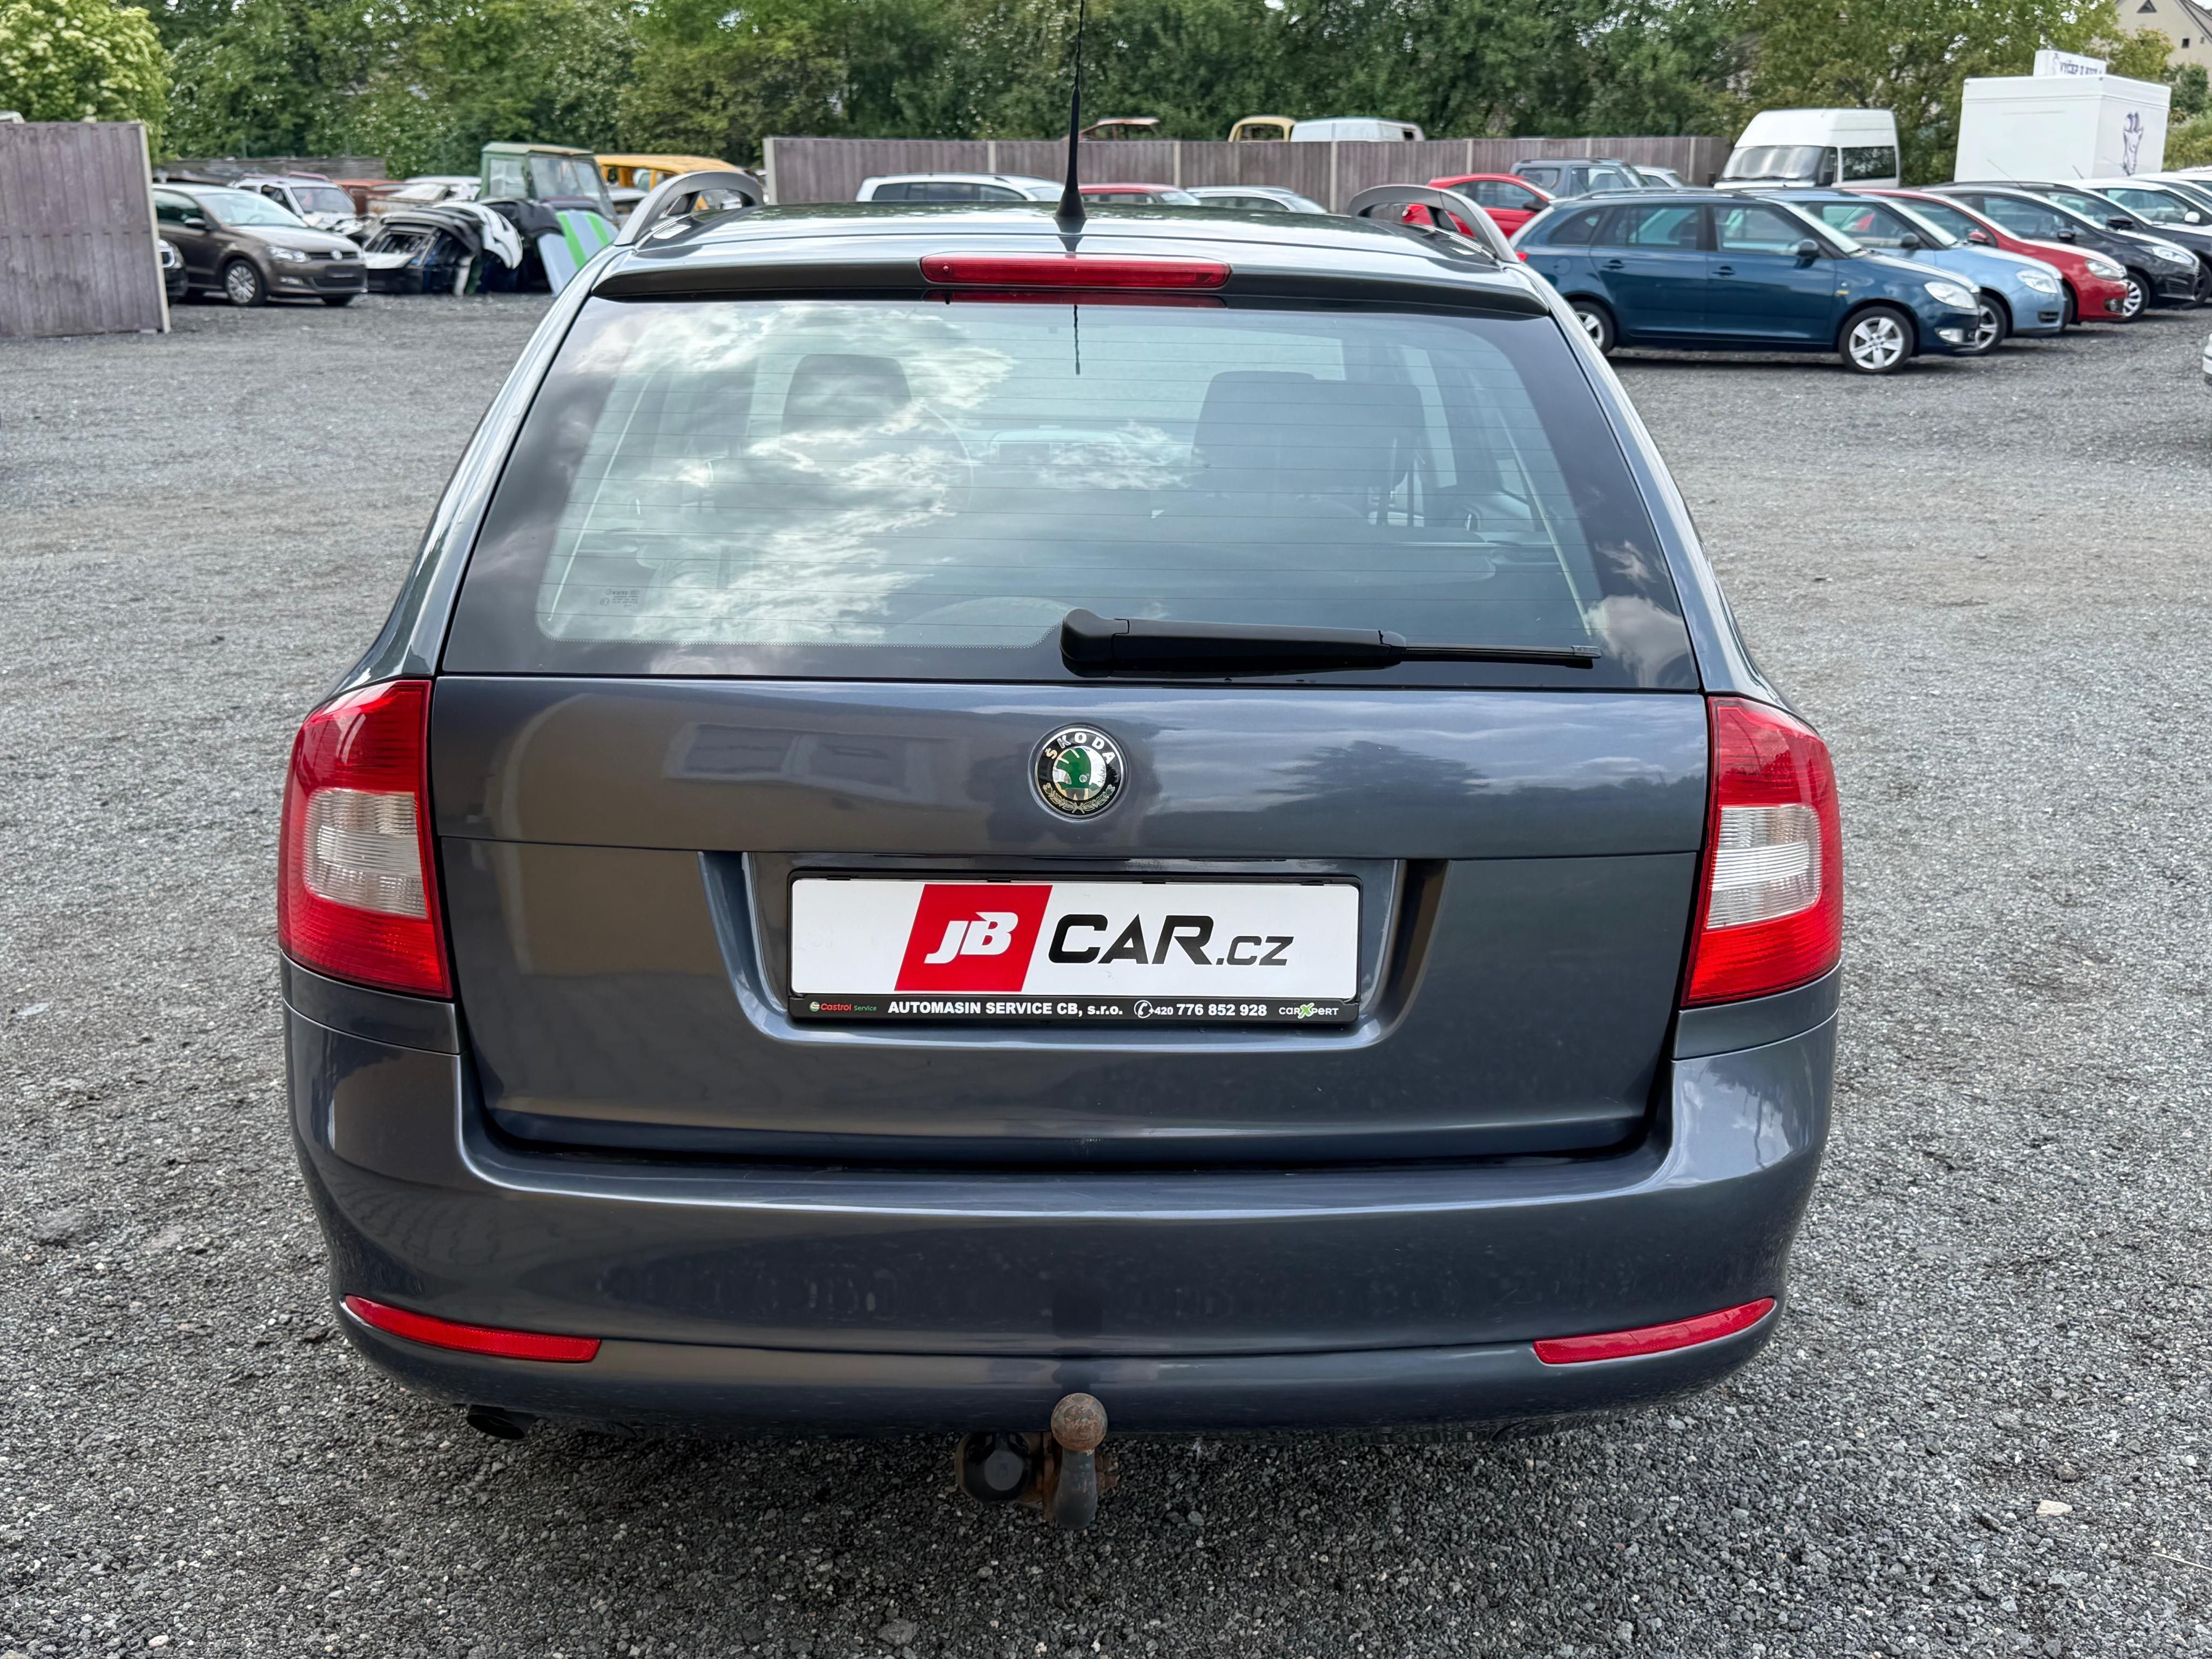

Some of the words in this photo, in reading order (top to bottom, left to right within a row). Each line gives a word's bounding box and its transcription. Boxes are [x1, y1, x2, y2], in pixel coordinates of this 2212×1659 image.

[1044, 732, 1116, 764] ŠKODA
[924, 911, 1019, 964] JB
[820, 1003, 852, 1011] Castrol
[888, 1001, 981, 1014] AUTOMASIN
[986, 1002, 1053, 1014] SERVICE
[1057, 1003, 1082, 1017] CB,
[1087, 1004, 1123, 1015] s.r.o.
[1149, 1007, 1174, 1016] +420
[1176, 1003, 1204, 1016] 776
[1208, 1003, 1236, 1016] 852
[1239, 1004, 1267, 1016] 928
